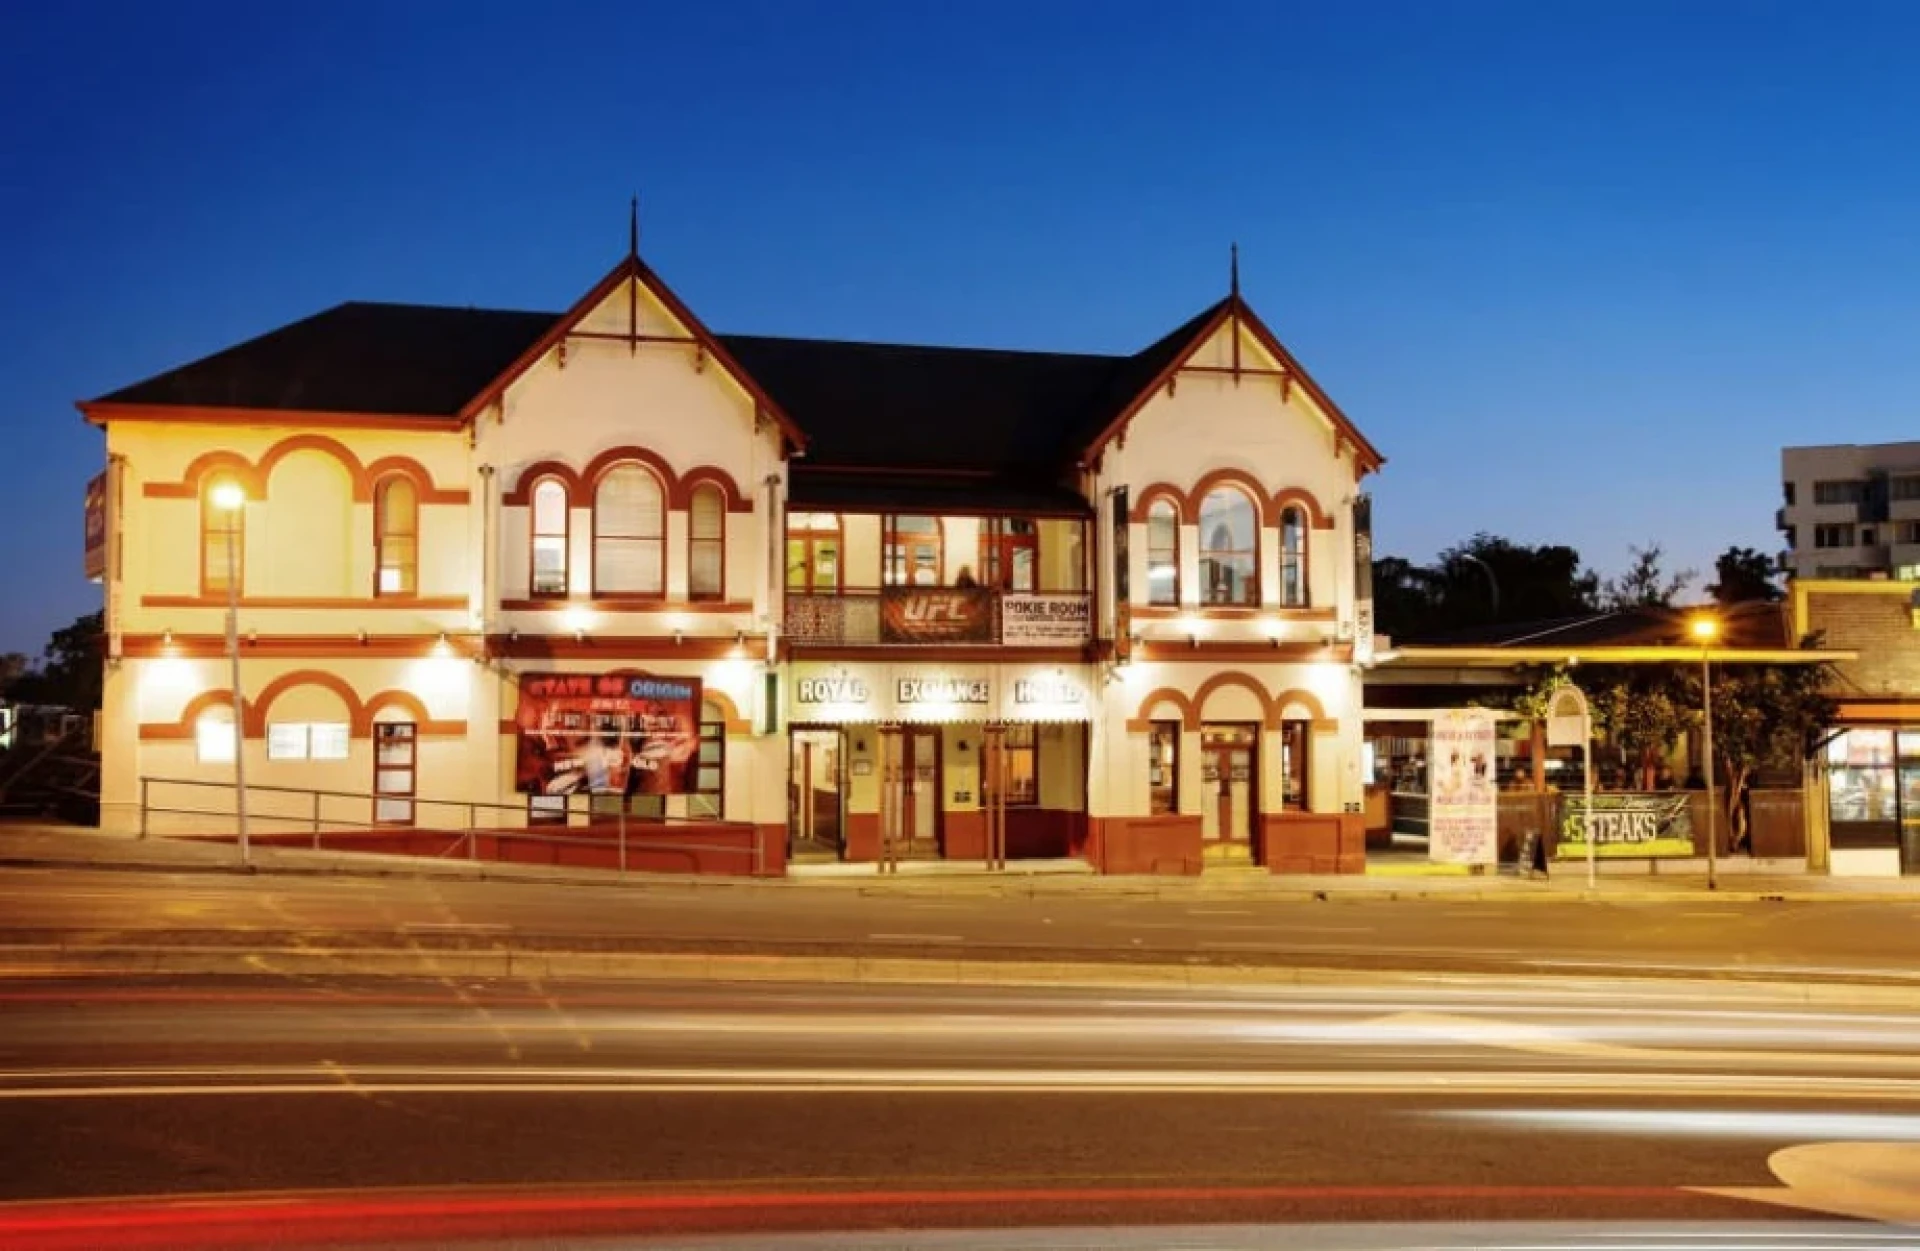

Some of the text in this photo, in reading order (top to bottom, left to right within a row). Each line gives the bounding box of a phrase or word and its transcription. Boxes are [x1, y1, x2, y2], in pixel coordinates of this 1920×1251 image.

[904, 595, 968, 620] UFC
[1004, 601, 1089, 615] POKIE ROOM
[631, 680, 692, 698] ORIGIN
[797, 679, 866, 703] ROYAL
[898, 679, 989, 704] EXCHANGE
[1563, 814, 1583, 842] $5
